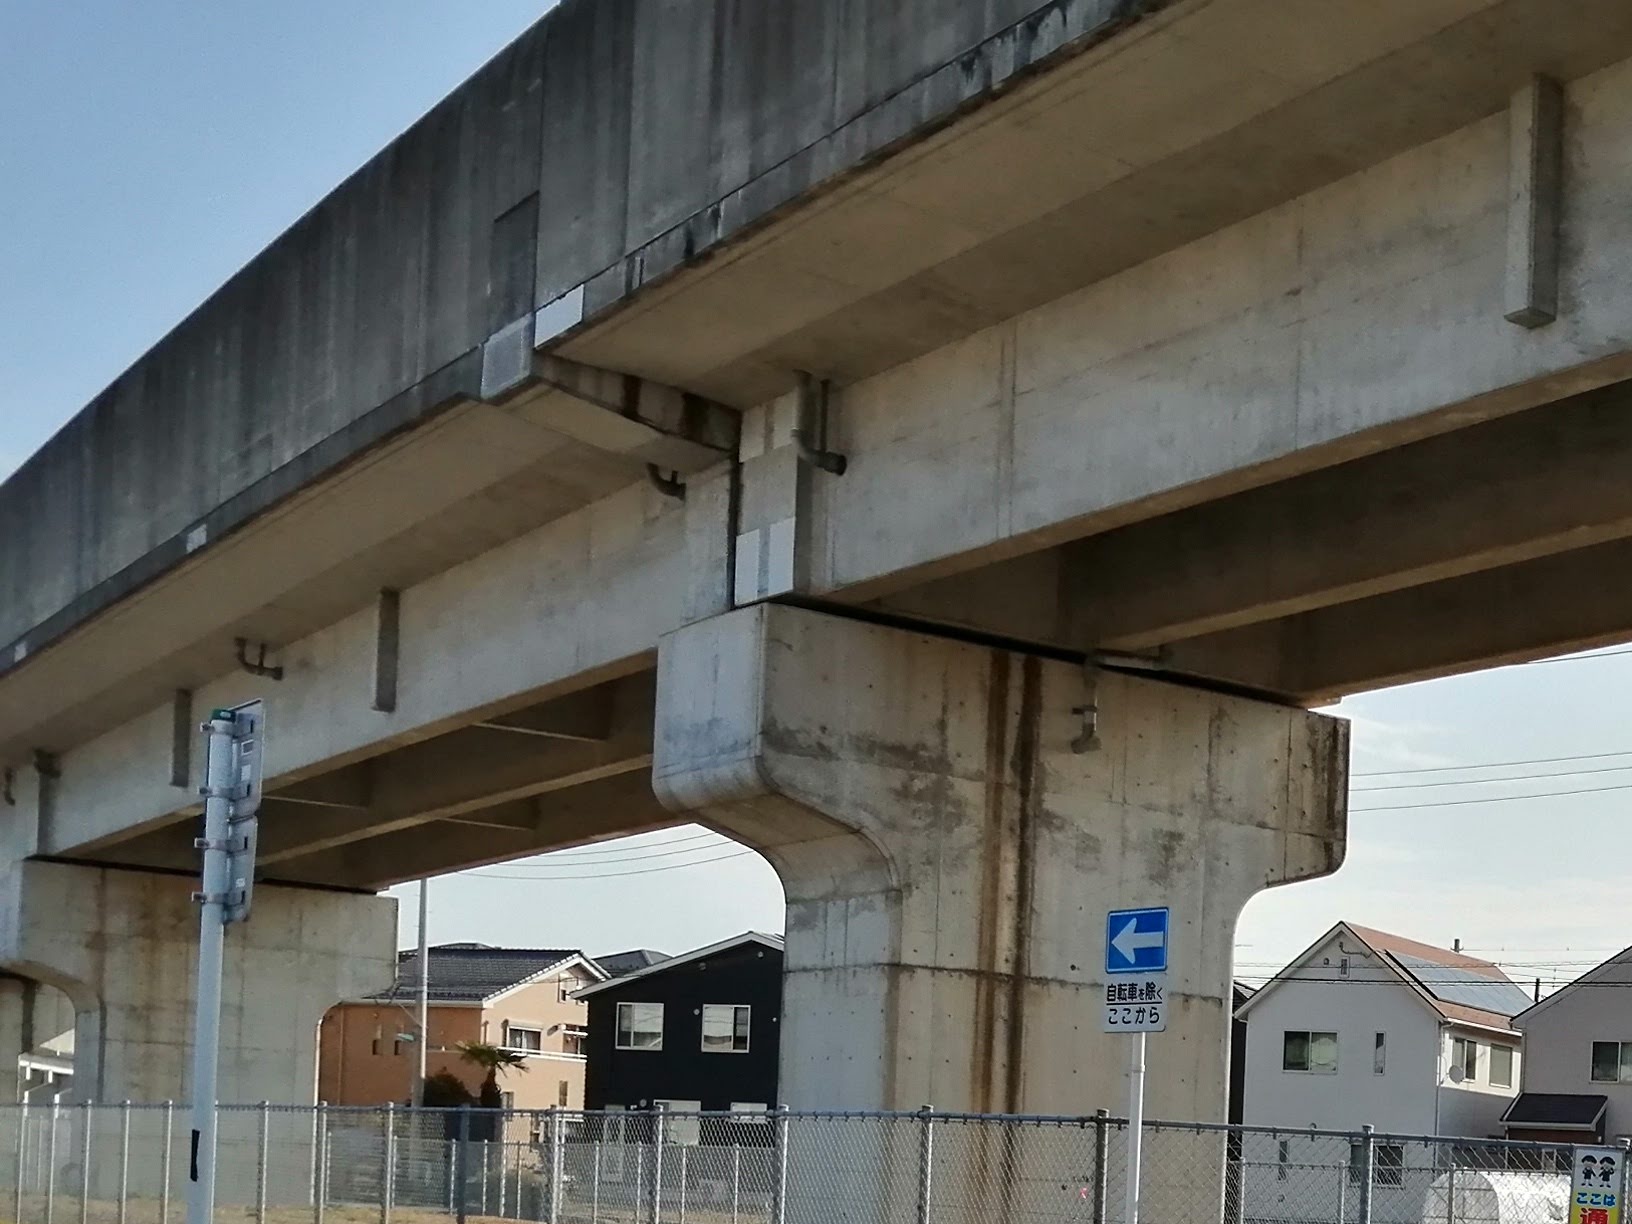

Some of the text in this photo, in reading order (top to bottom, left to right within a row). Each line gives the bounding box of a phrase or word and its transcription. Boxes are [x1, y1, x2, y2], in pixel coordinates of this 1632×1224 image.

[1107, 982, 1162, 1001] 自転車を除く
[1109, 1007, 1159, 1024] ここから
[1577, 1192, 1615, 1206] ここは
